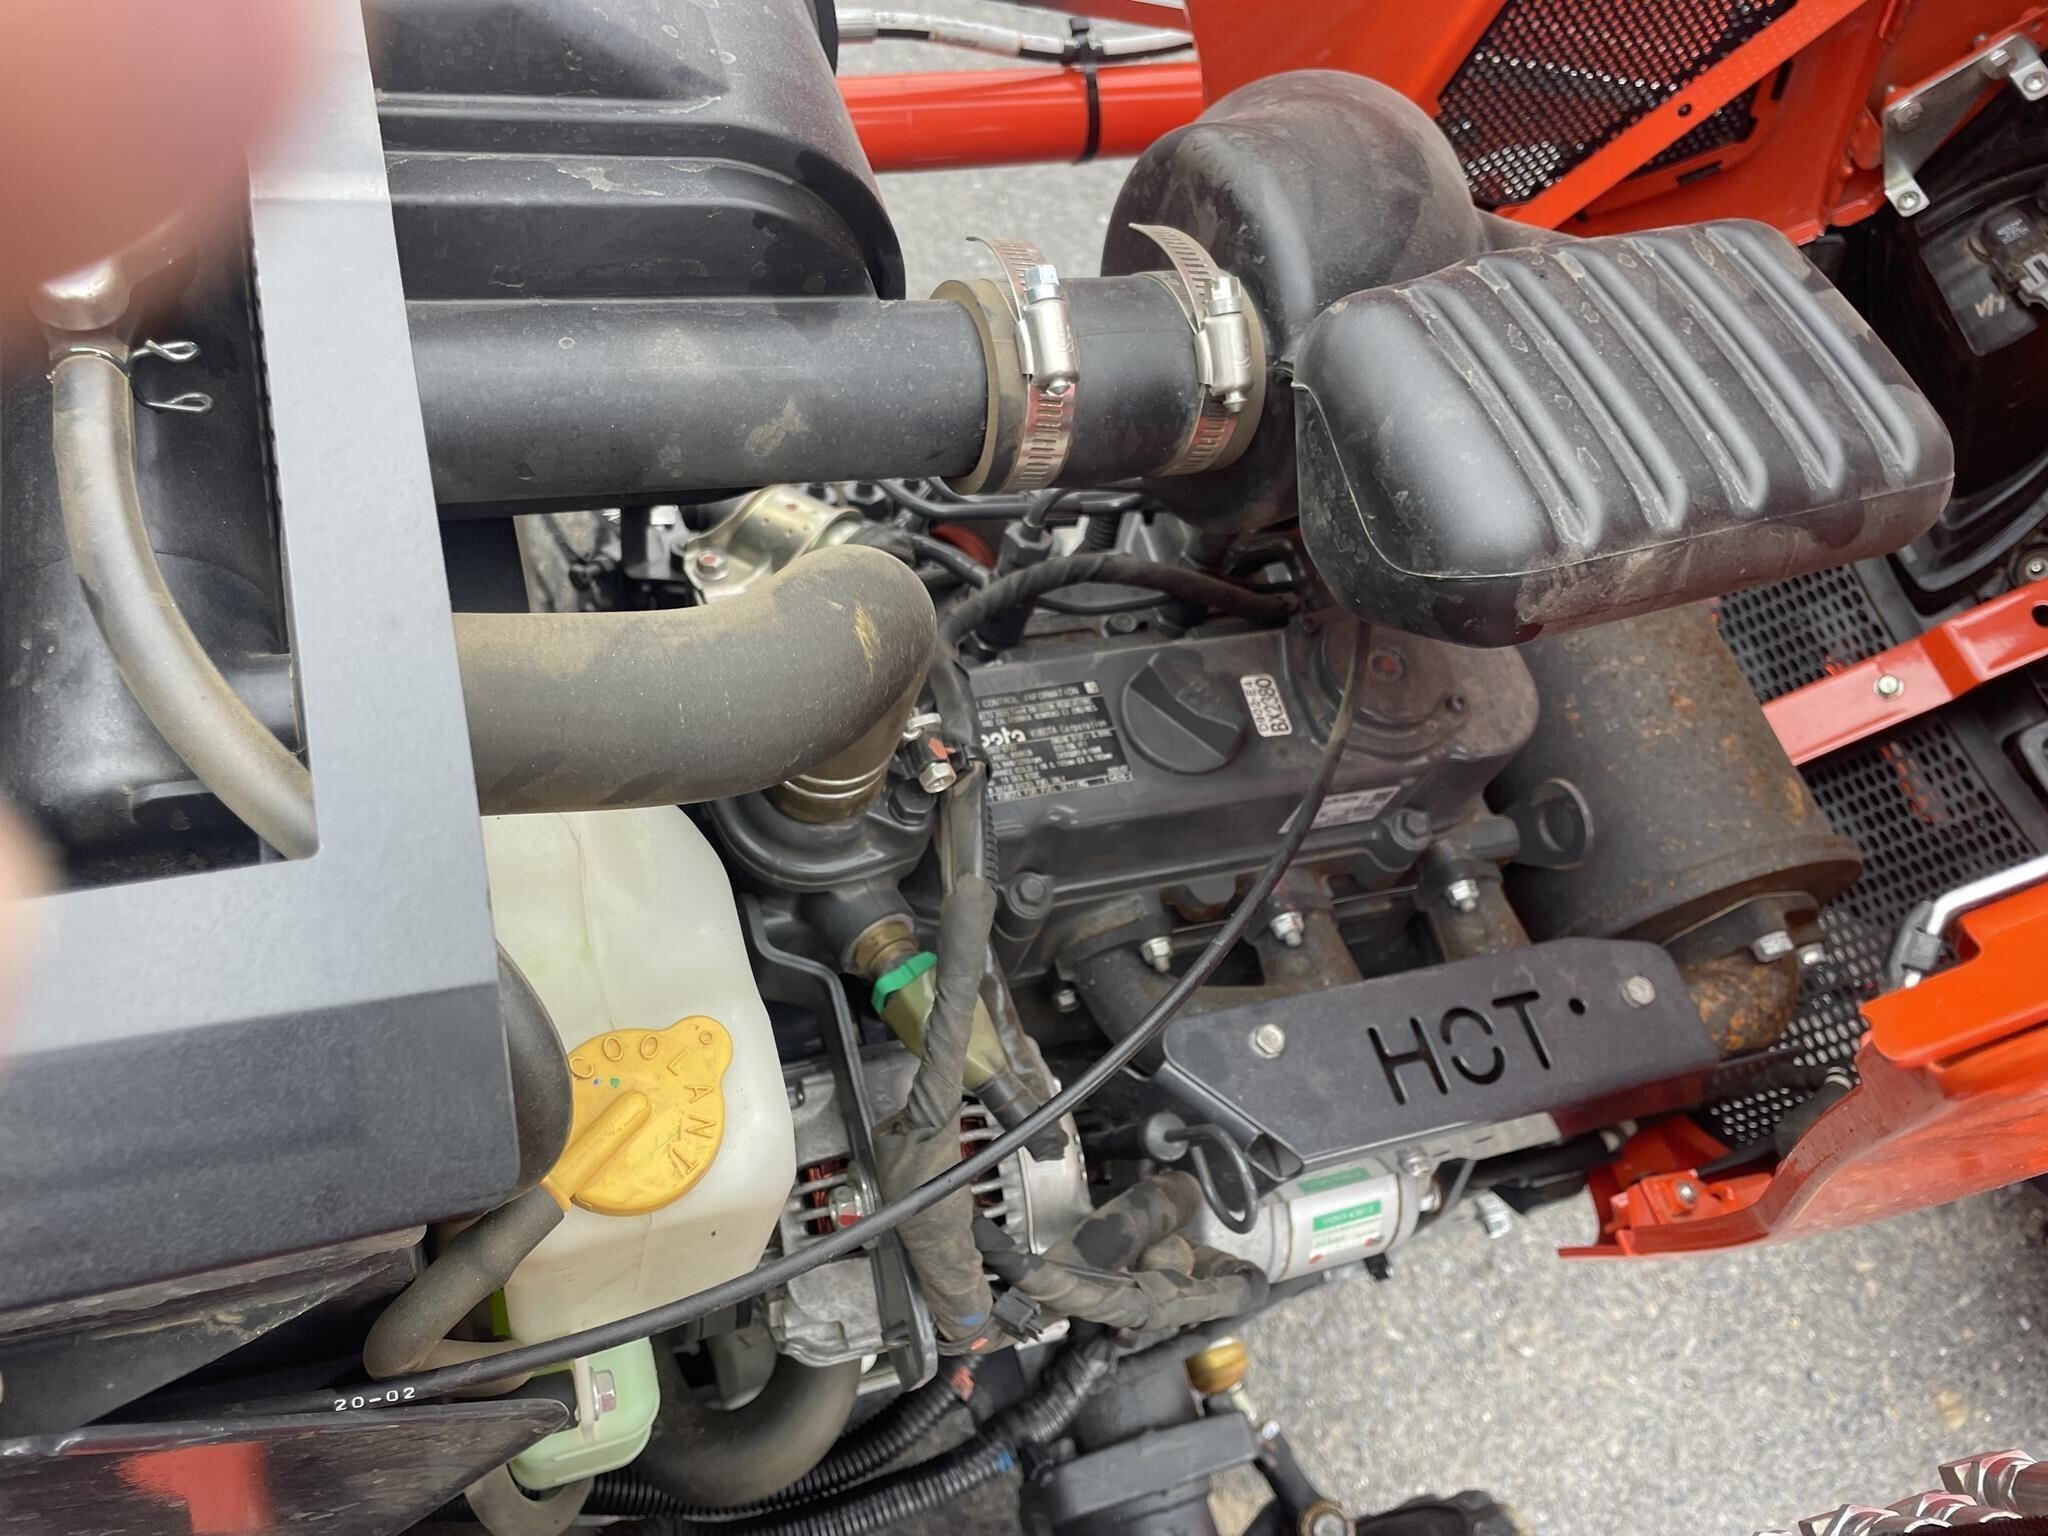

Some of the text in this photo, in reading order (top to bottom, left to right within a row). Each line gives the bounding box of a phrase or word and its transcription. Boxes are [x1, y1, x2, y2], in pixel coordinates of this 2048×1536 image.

[1024, 686, 1080, 702] INFORMATION
[1255, 677, 1289, 734] BX2380
[1367, 990, 1551, 1105] HOT
[569, 1034, 718, 1176] COOLANT
[334, 1386, 416, 1412] 20-02
